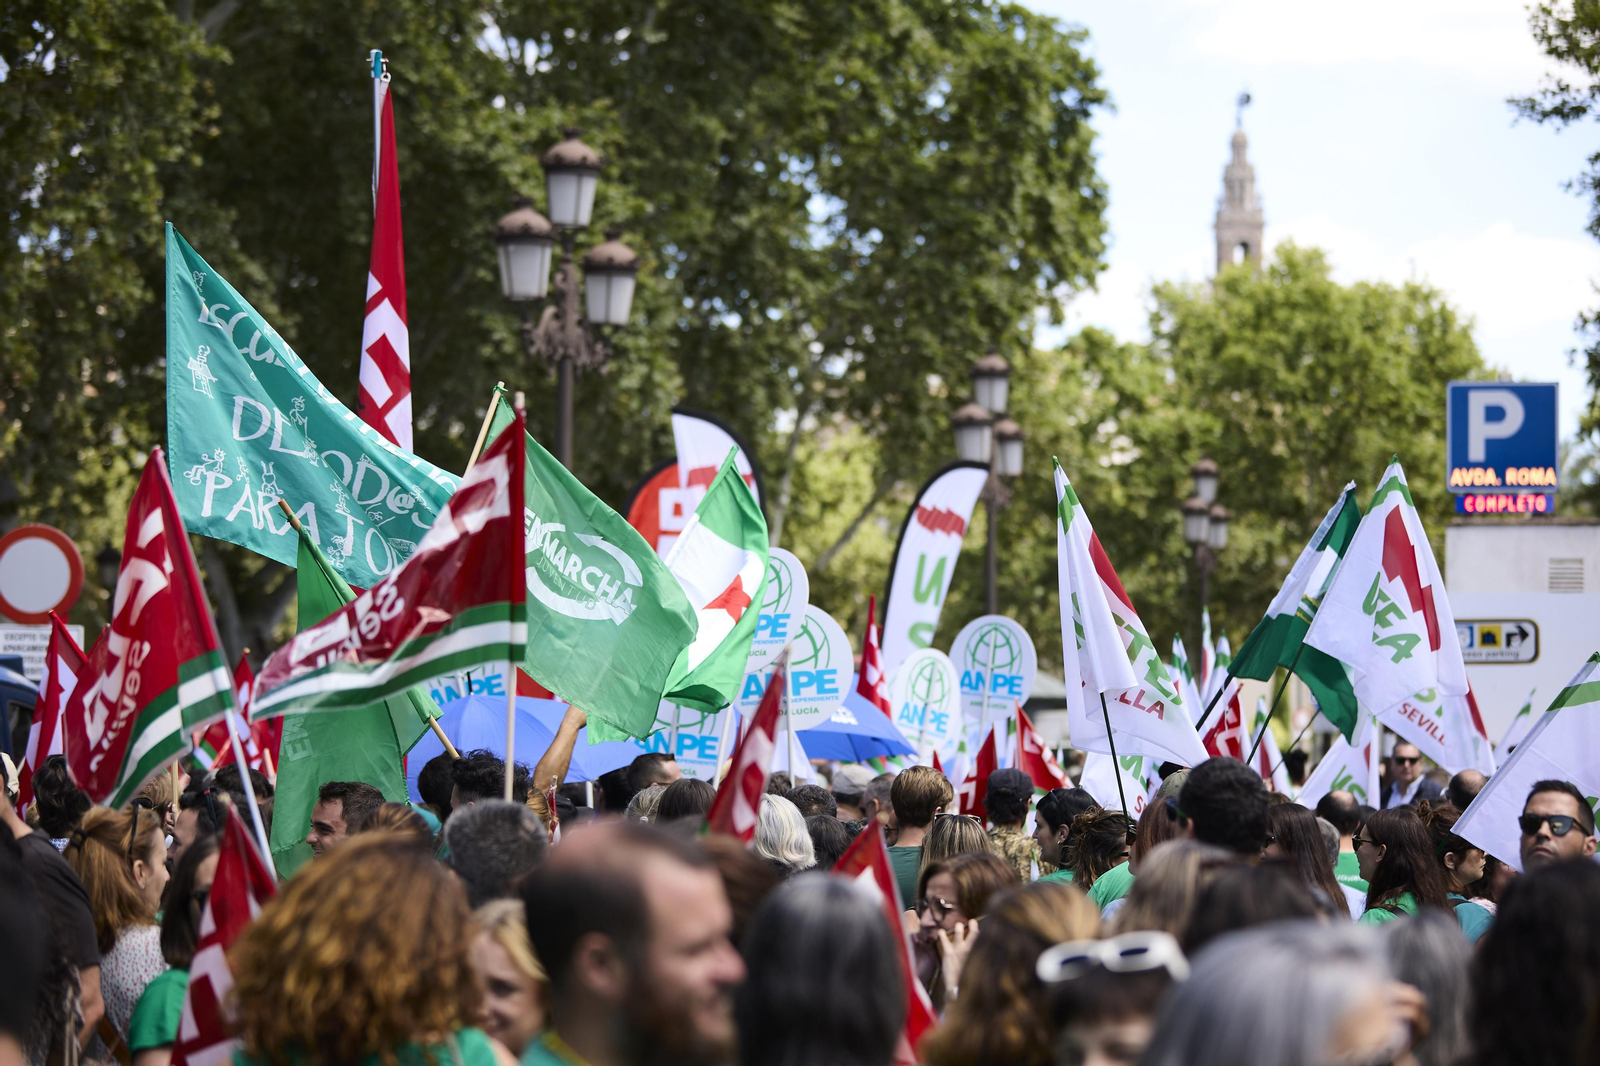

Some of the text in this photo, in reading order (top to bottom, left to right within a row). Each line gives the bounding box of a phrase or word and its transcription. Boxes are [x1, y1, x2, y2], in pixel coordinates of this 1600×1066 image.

[1468, 390, 1525, 463] P
[1450, 467, 1557, 487] AVDA. ROMA
[1464, 494, 1547, 513] COMPLETO
[536, 557, 597, 611] JUVENTUD
[542, 531, 634, 616] MARCHA
[753, 613, 791, 638] PE
[741, 669, 839, 699] APE
[960, 670, 1023, 696] ANPE
[1398, 702, 1446, 746] SEVILL
